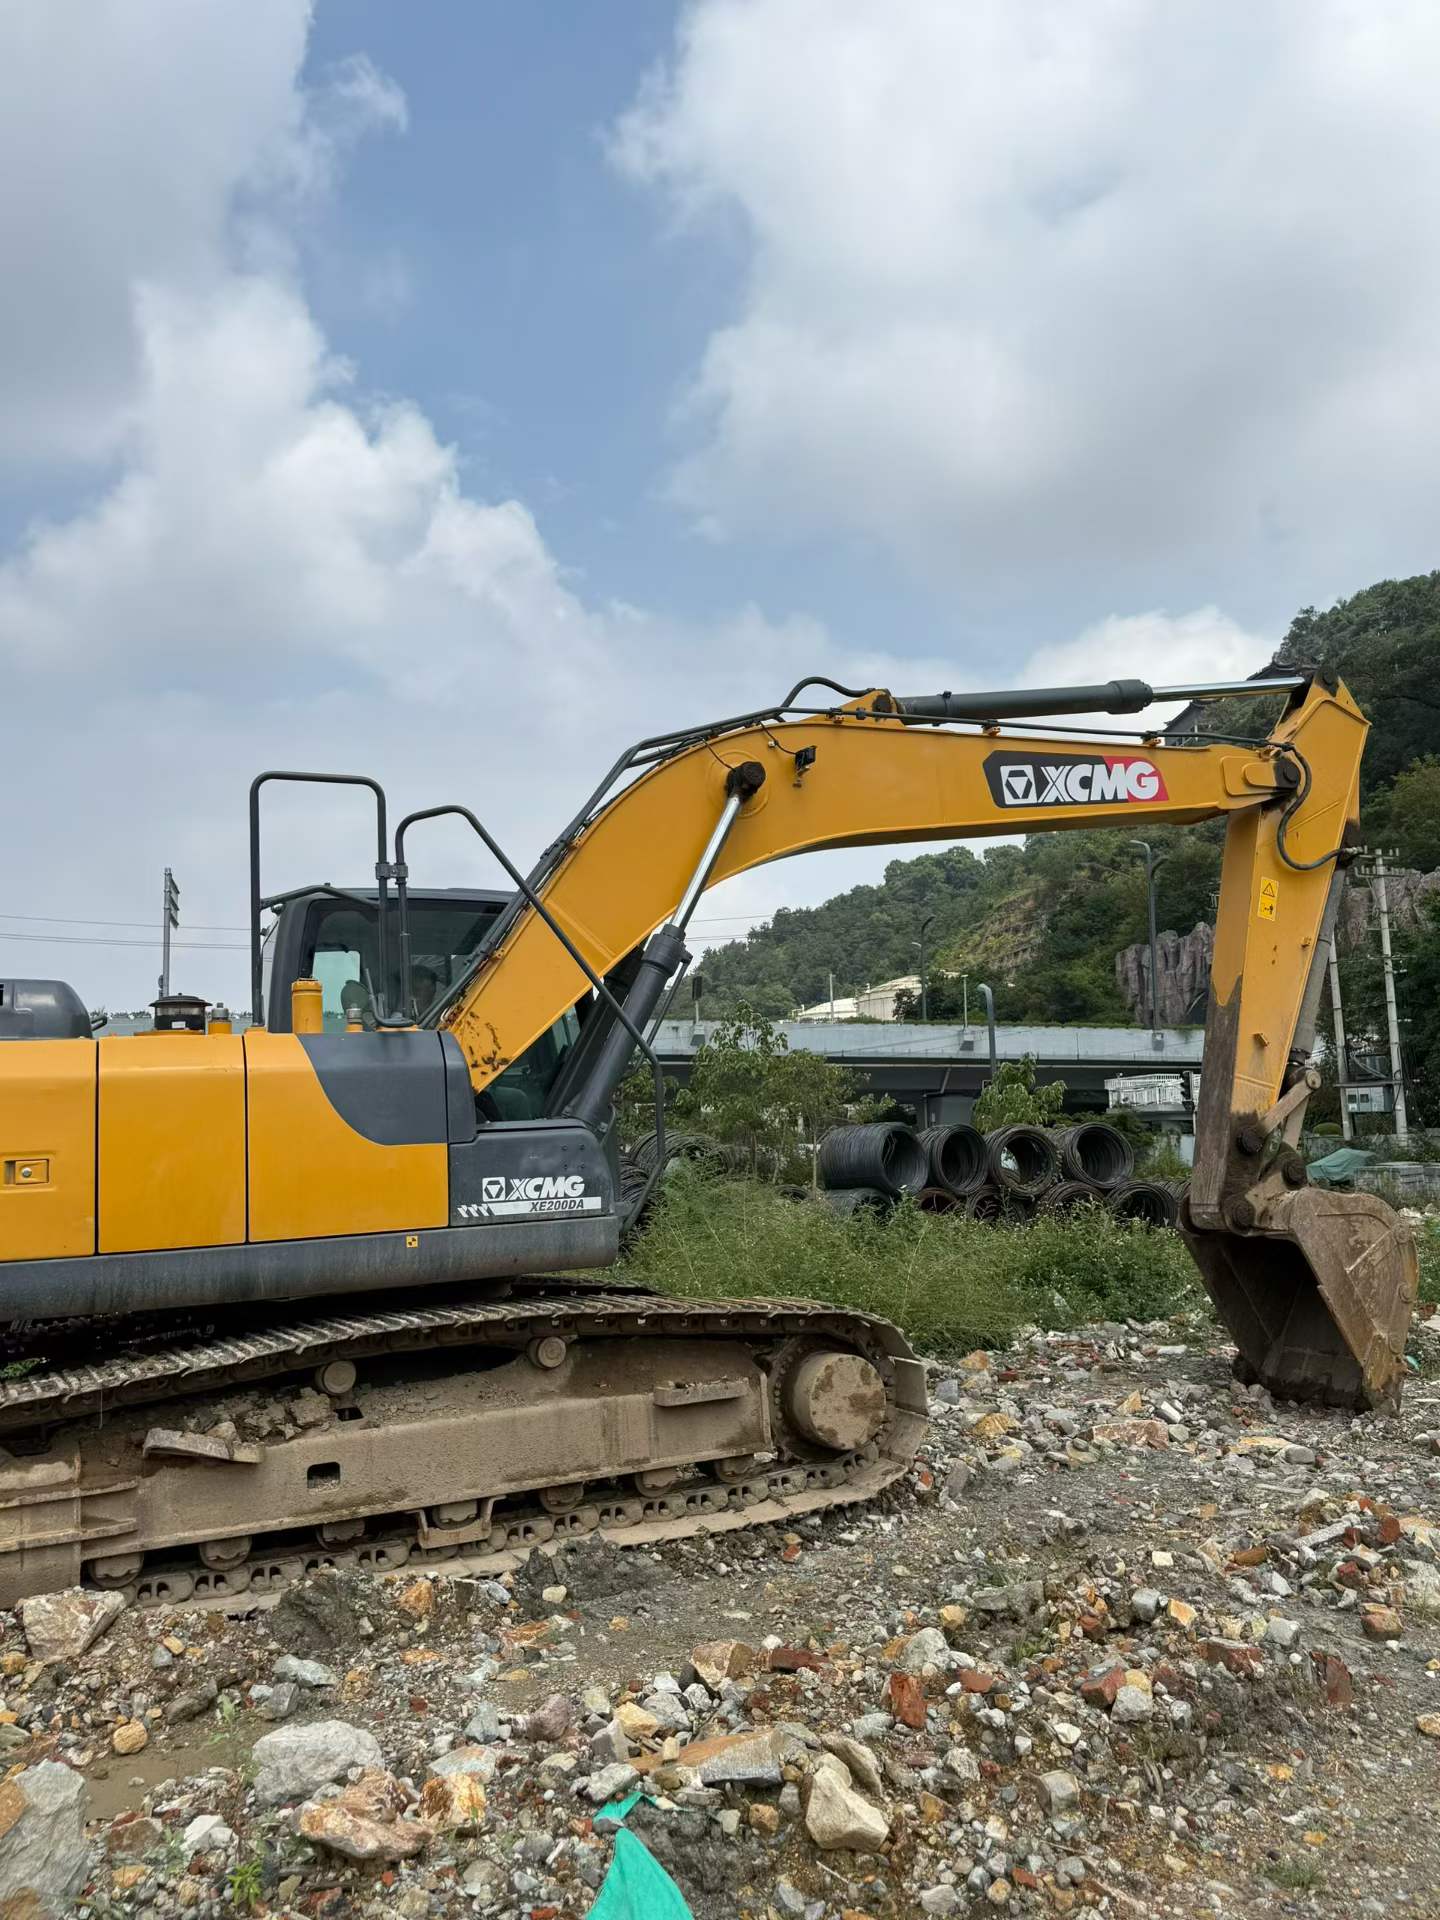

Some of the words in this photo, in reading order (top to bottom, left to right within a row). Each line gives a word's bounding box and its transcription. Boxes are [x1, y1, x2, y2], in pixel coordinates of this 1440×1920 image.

[1037, 761, 1159, 803] XCMG
[506, 1175, 585, 1200] XCMG
[529, 1199, 584, 1212] XE200DA
